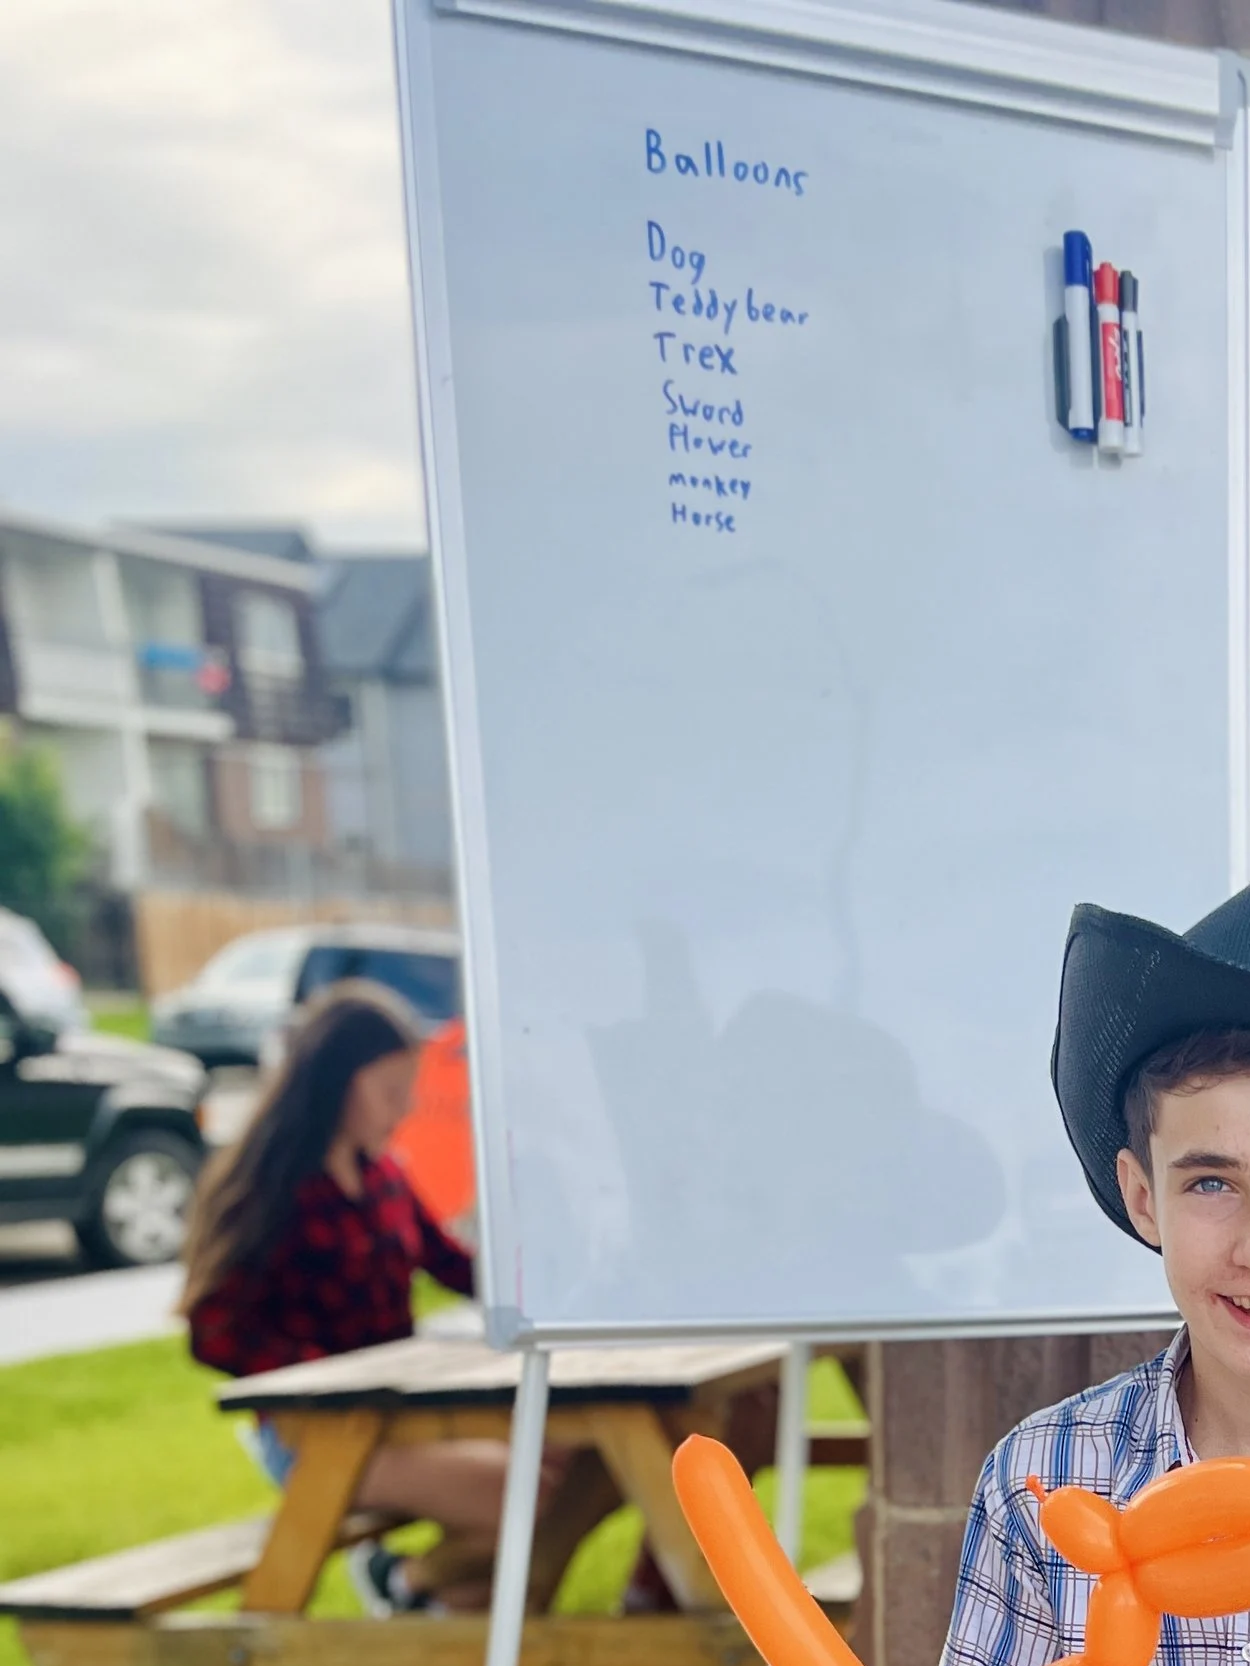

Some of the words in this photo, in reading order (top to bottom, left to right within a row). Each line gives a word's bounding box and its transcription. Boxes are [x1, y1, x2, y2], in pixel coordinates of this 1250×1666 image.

[645, 128, 808, 196] Balloons
[647, 220, 706, 285] Dog
[663, 379, 744, 427] Sword
[669, 423, 753, 459] Flower
[668, 472, 751, 500] monkey
[671, 502, 736, 533] Horse
